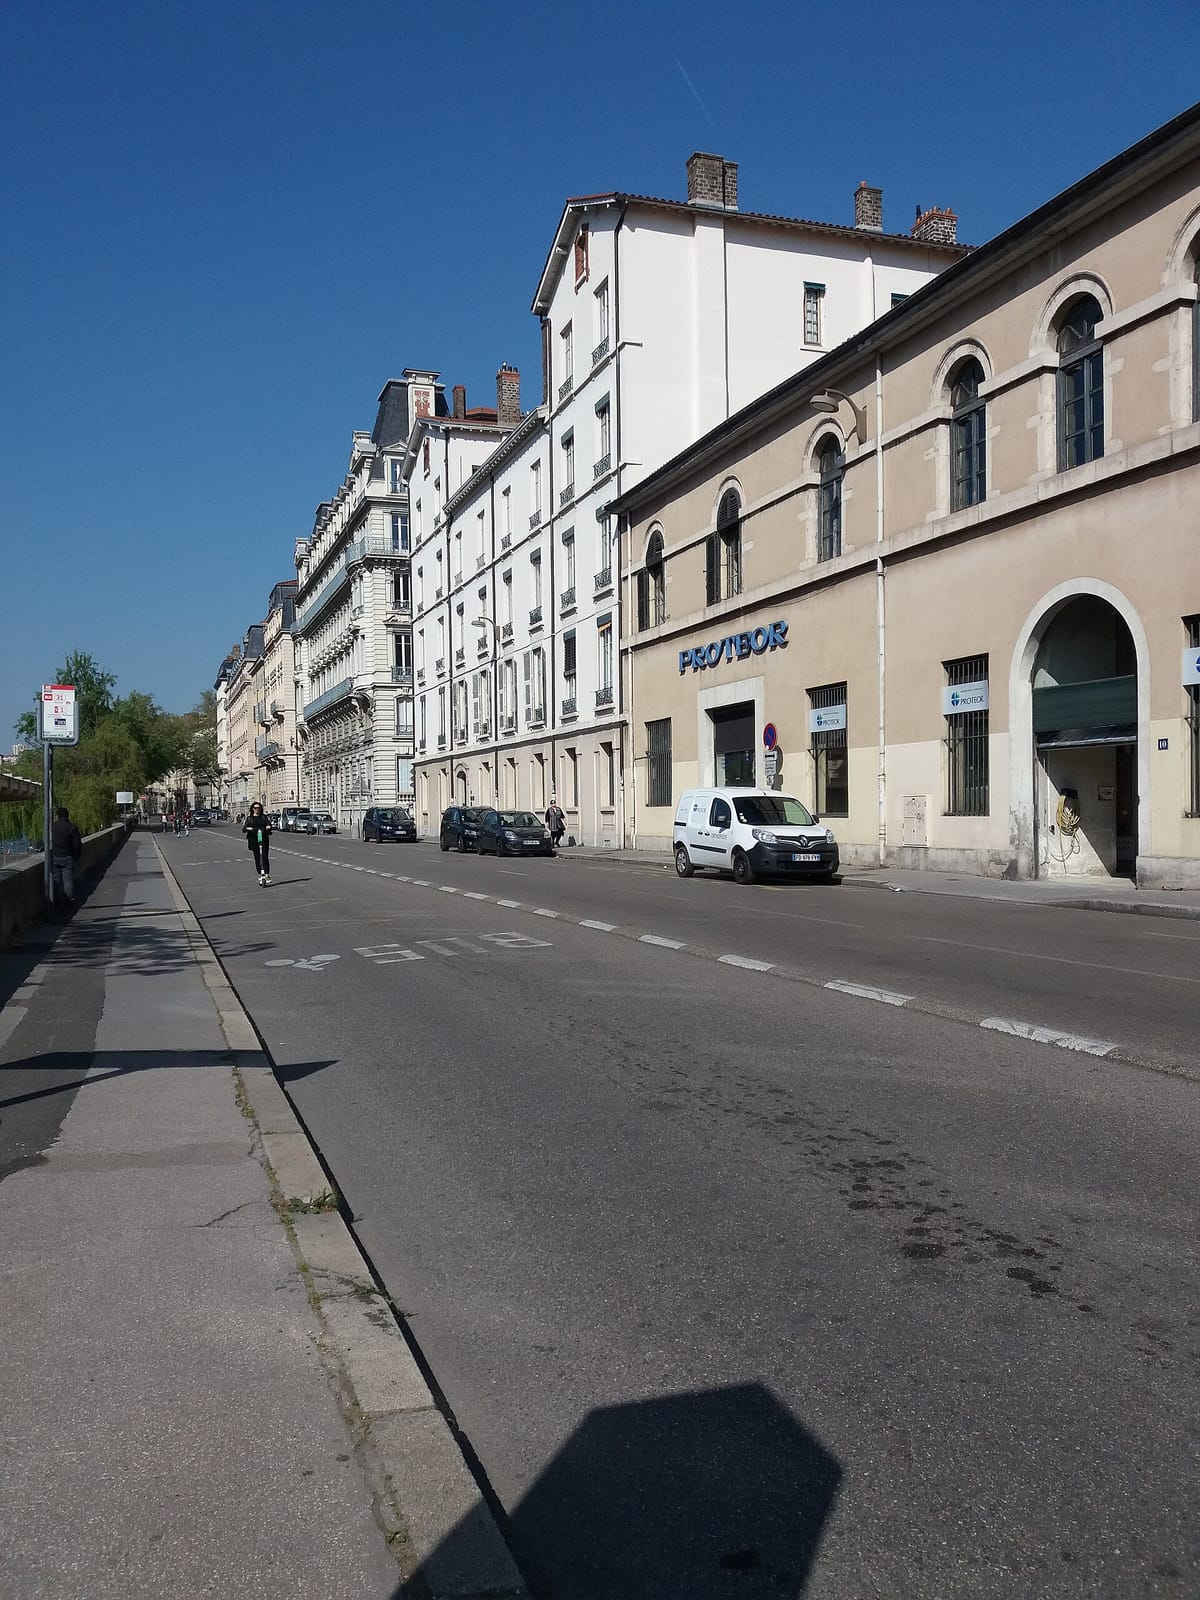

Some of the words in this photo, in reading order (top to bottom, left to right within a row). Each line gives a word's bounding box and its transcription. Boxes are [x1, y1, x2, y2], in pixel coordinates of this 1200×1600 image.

[678, 620, 788, 674] PROTEOR
[960, 695, 984, 705] PROTEOR
[1159, 740, 1167, 749] 10
[352, 931, 553, 964] BUS
